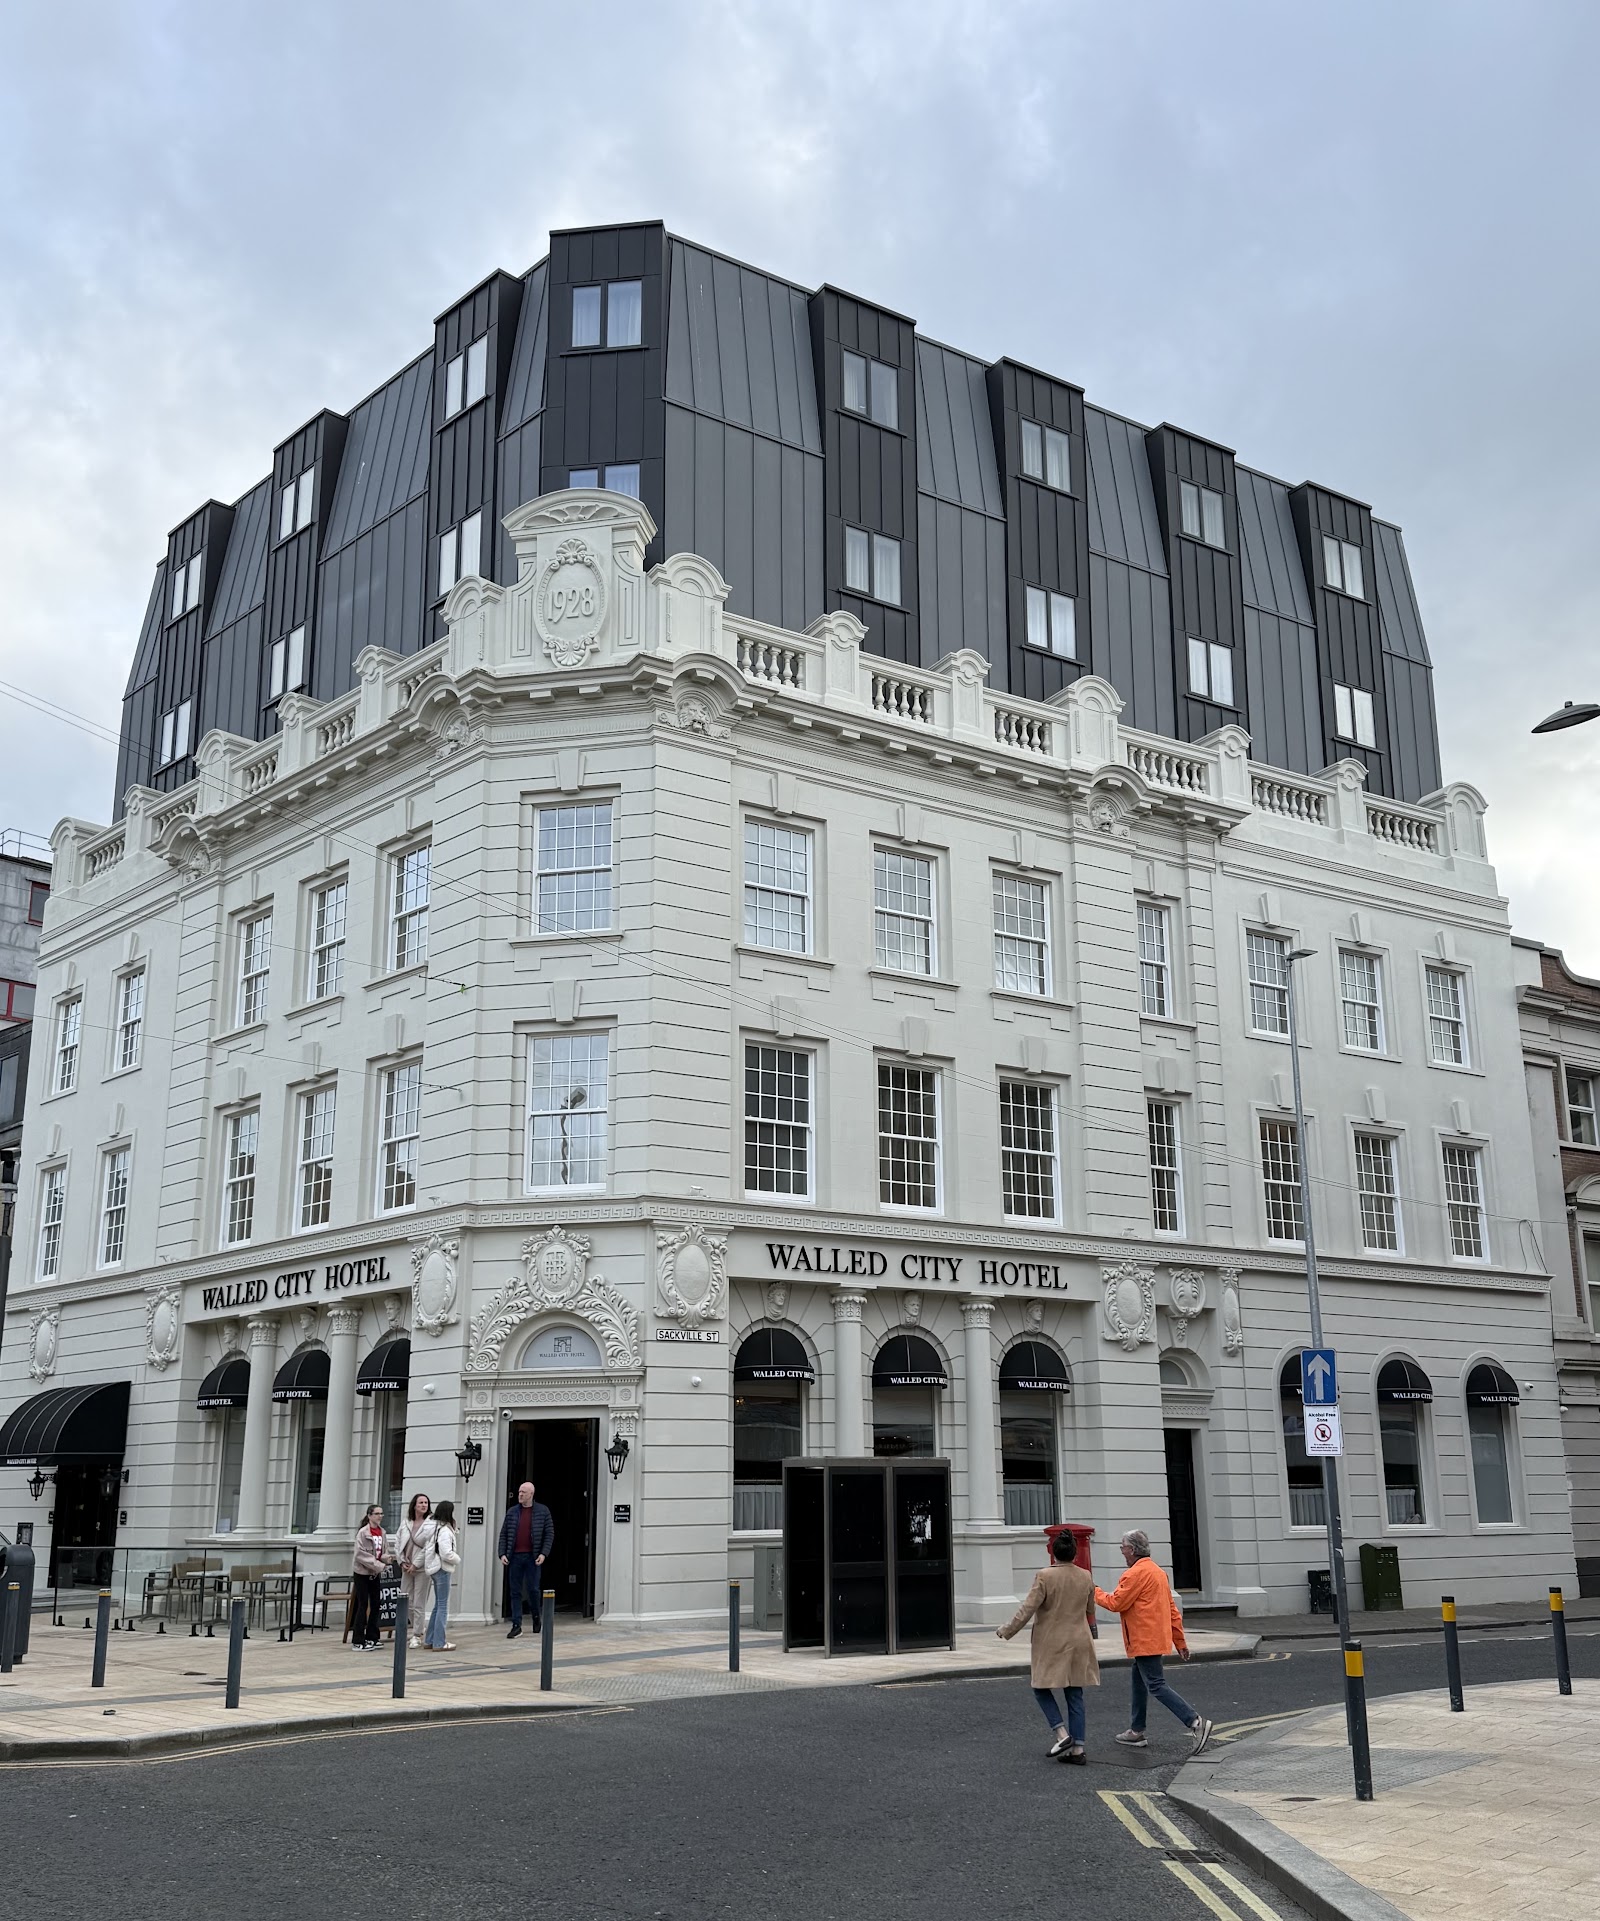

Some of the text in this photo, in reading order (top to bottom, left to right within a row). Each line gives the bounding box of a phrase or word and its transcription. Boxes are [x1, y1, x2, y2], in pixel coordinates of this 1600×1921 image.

[547, 587, 595, 624] 1928
[766, 1243, 1068, 1290] WALLED CITY HOTEL
[202, 1256, 390, 1311] WALLED CITY HOTEL
[658, 1330, 717, 1341] SACKVILLE ST
[752, 1370, 786, 1378] WALLED
[786, 1370, 804, 1378] CITY
[890, 1376, 922, 1384] WALLED
[922, 1376, 939, 1384] CITY
[372, 1381, 400, 1389] HOTEL
[1018, 1381, 1049, 1389] WALLED
[286, 1390, 312, 1398] HOTEL
[209, 1398, 233, 1406] HOTEL
